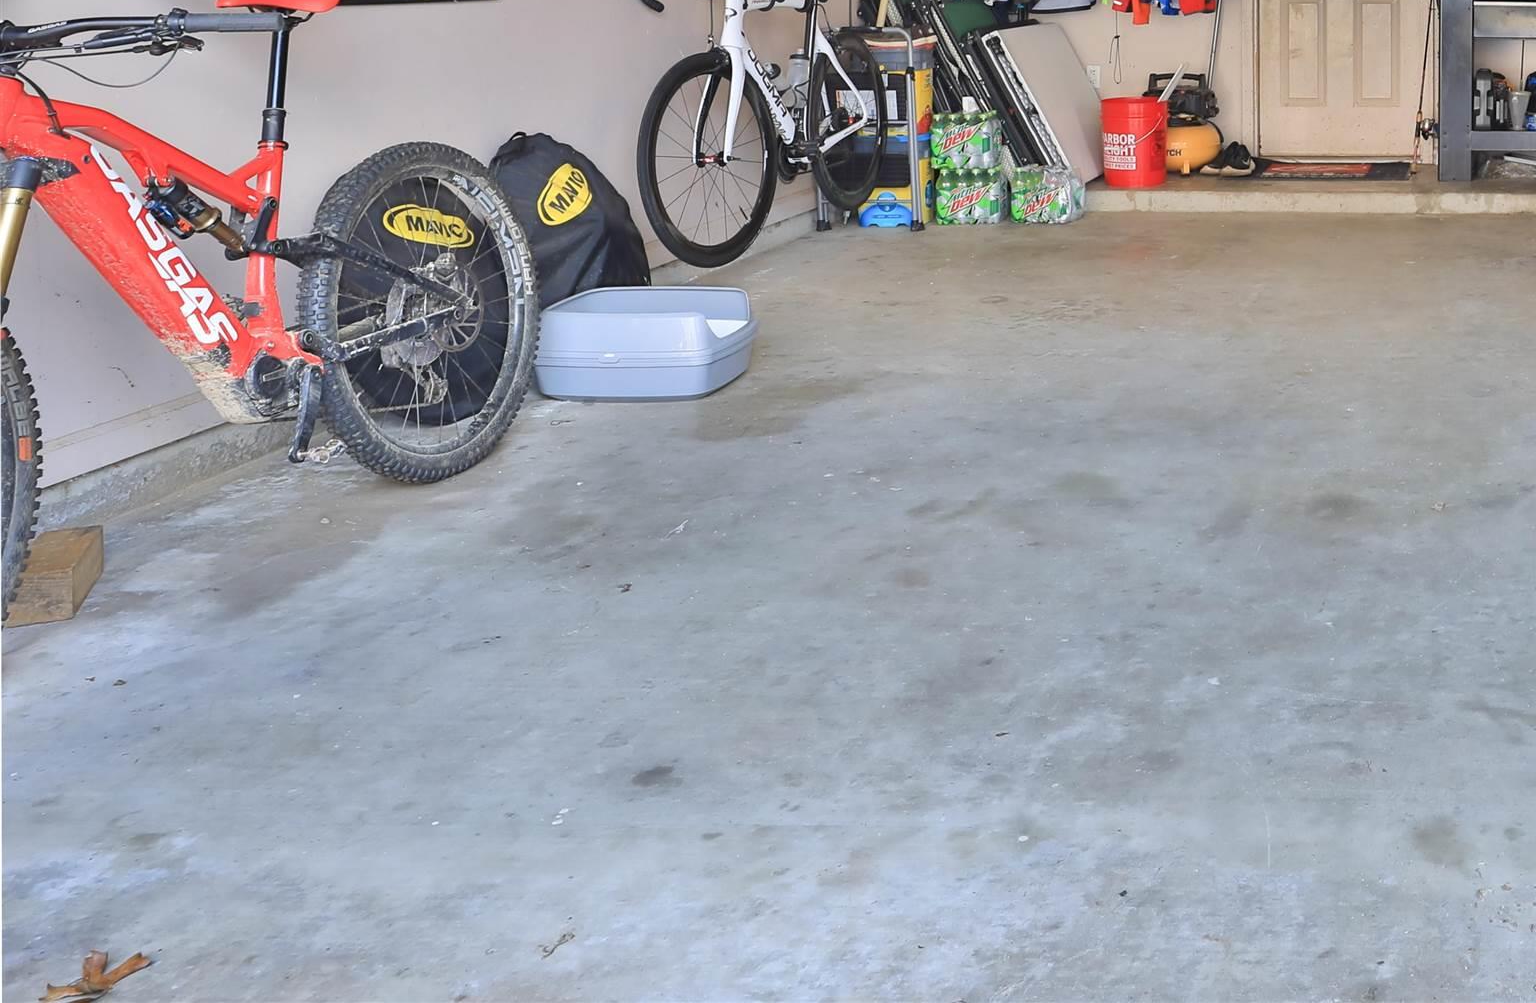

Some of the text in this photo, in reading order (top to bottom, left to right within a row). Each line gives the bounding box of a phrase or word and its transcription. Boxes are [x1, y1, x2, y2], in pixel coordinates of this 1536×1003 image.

[1104, 133, 1136, 145] ARBOR
[1104, 145, 1136, 157] EIGHT
[548, 168, 586, 215] MAVIC
[405, 213, 464, 239] MAVIC
